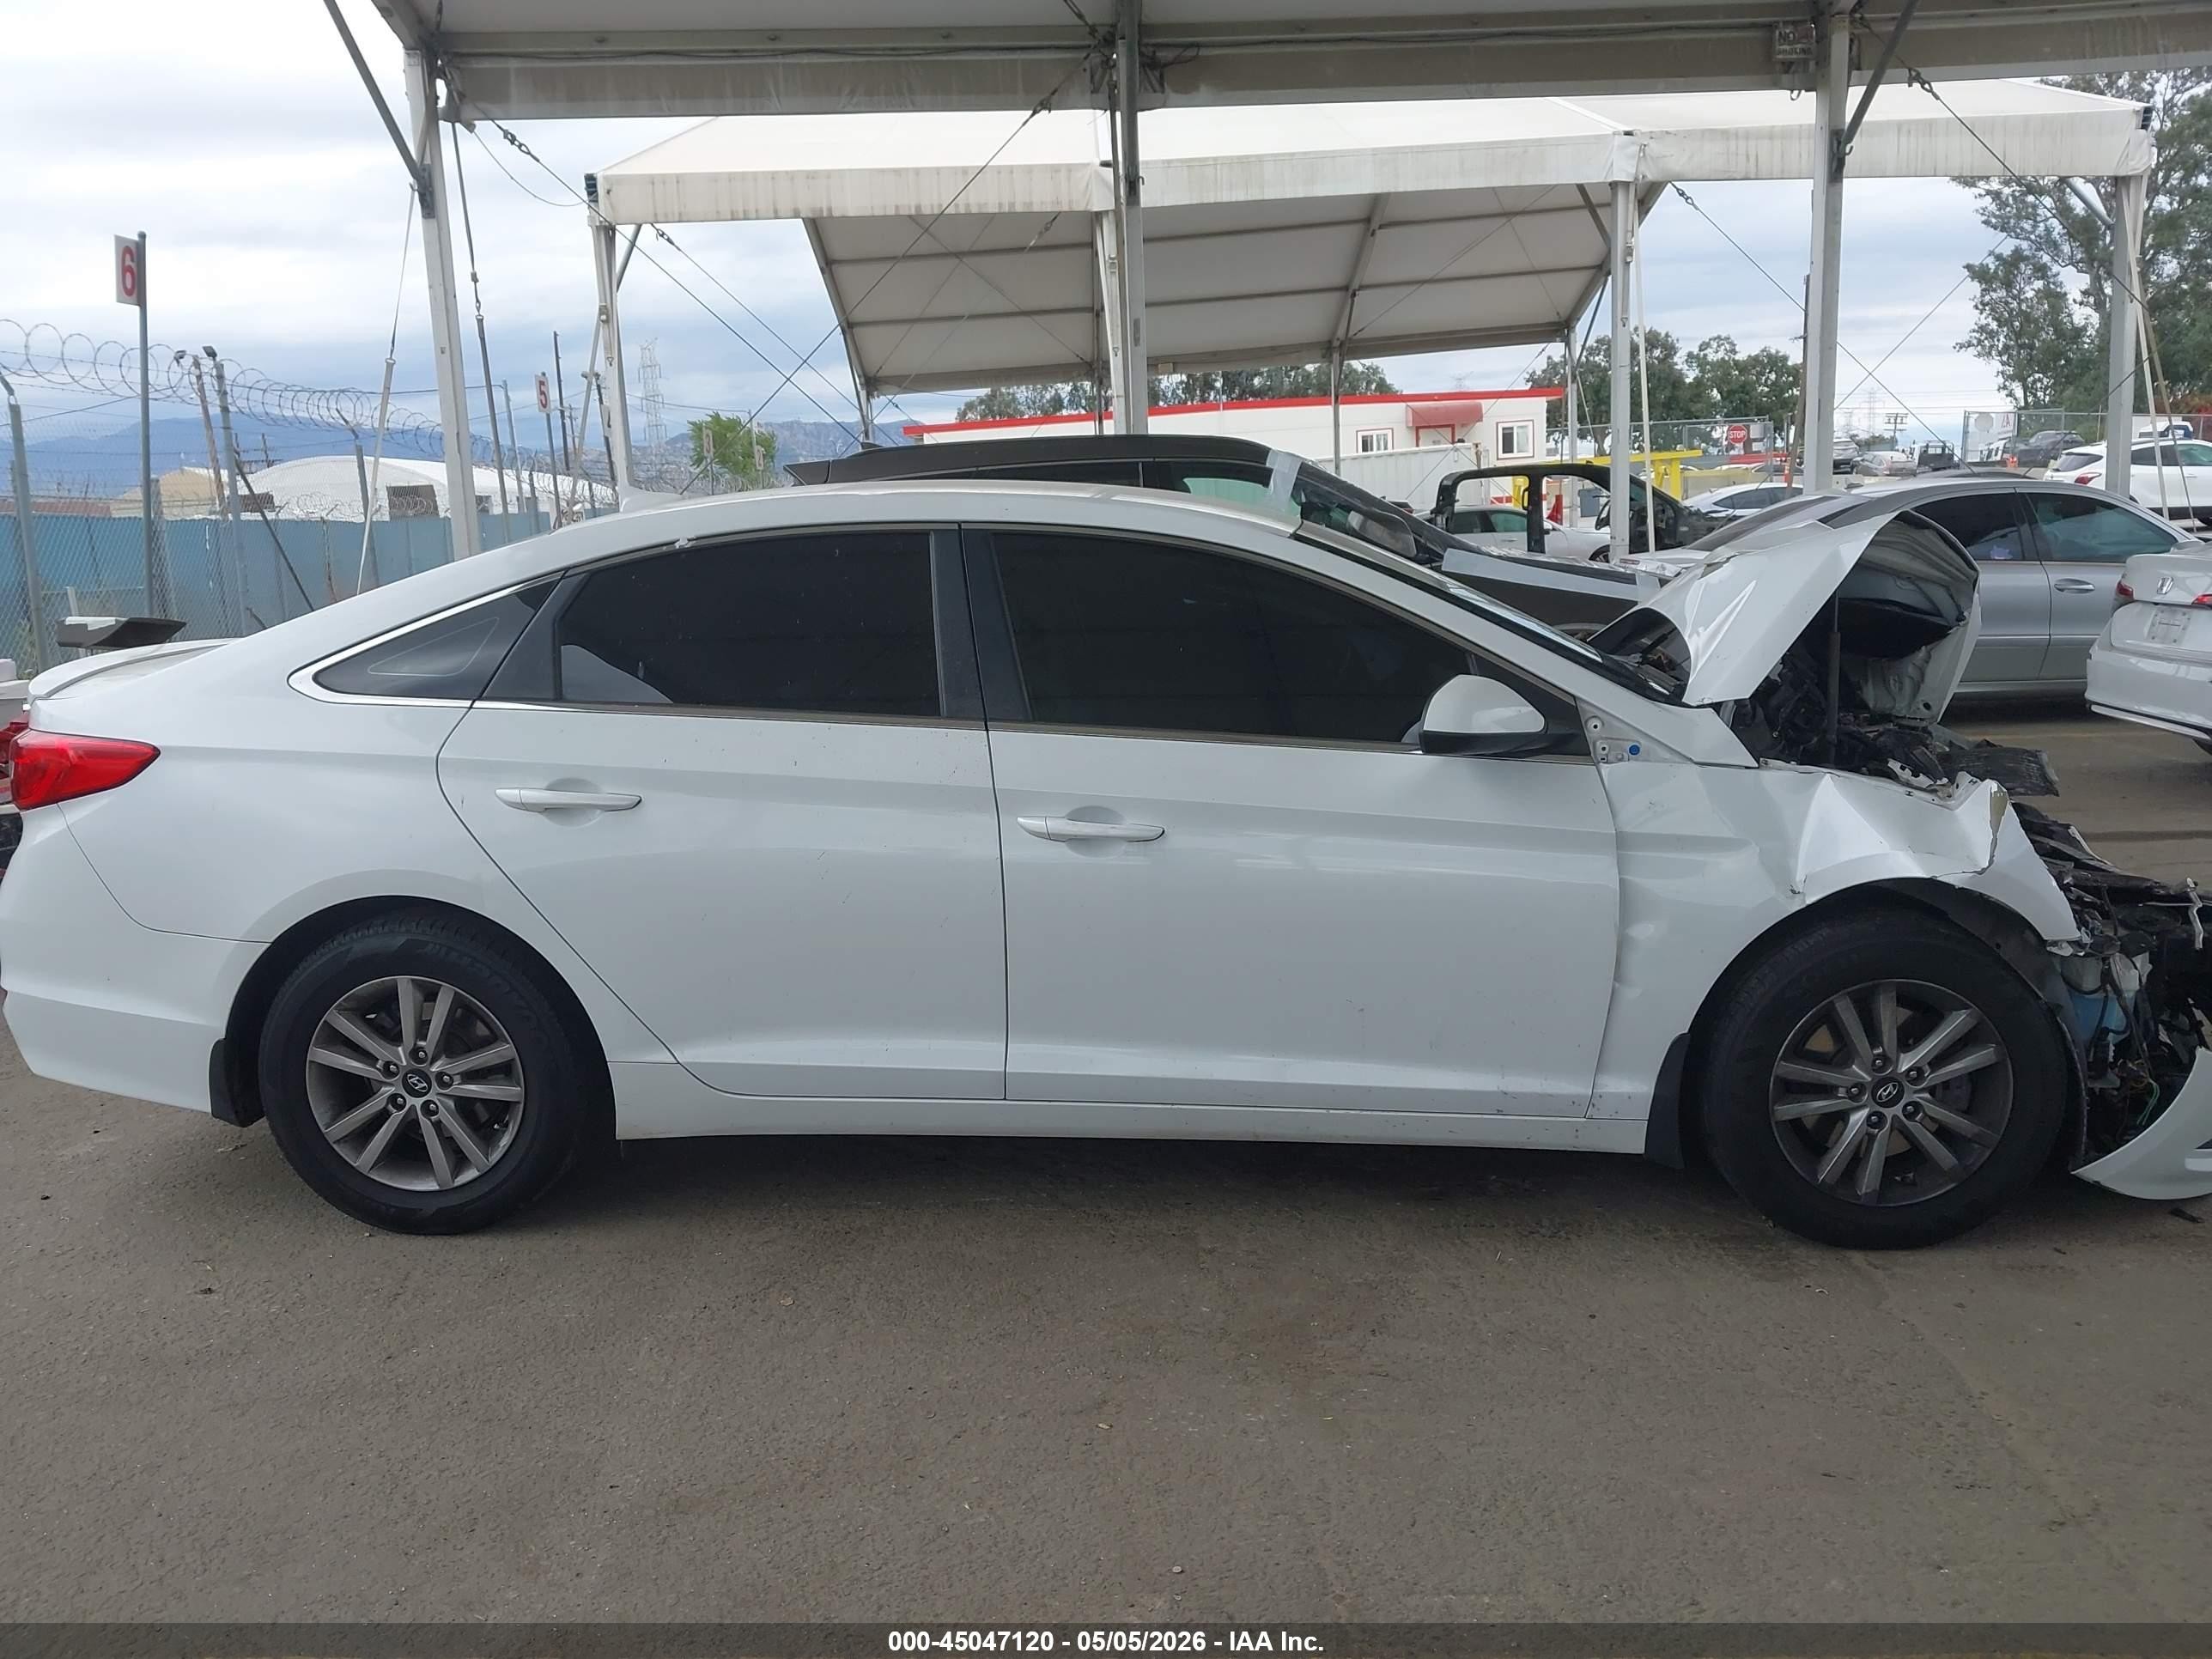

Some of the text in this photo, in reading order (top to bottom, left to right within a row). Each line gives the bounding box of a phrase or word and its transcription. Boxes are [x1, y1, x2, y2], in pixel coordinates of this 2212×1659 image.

[1778, 30, 1796, 42] NO
[122, 246, 136, 297] 6
[538, 380, 548, 409] 5
[1729, 430, 1746, 439] STOP
